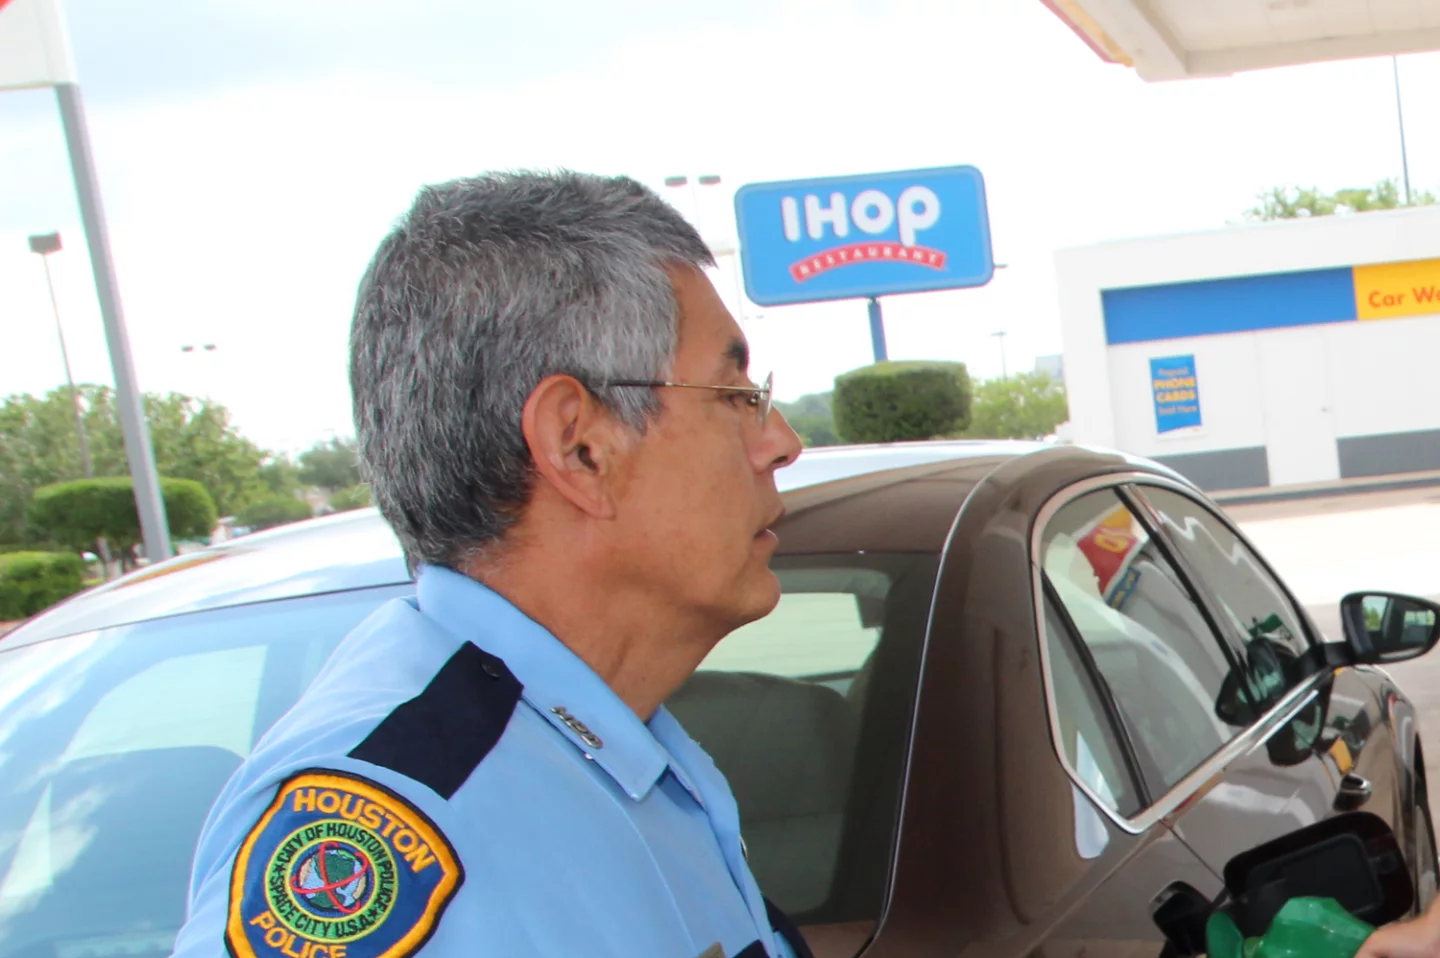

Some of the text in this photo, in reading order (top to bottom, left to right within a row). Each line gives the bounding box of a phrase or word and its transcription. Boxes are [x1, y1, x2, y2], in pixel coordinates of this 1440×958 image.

[781, 185, 941, 248] IHOP
[799, 245, 939, 277] RESTAURANT
[1368, 289, 1405, 309] Car
[293, 788, 436, 873] HOUSTON
[305, 825, 324, 841] OF
[327, 822, 387, 860] HOUSTON
[377, 860, 394, 914] POLICE
[269, 877, 297, 921] SPACE
[294, 914, 331, 936] CITY
